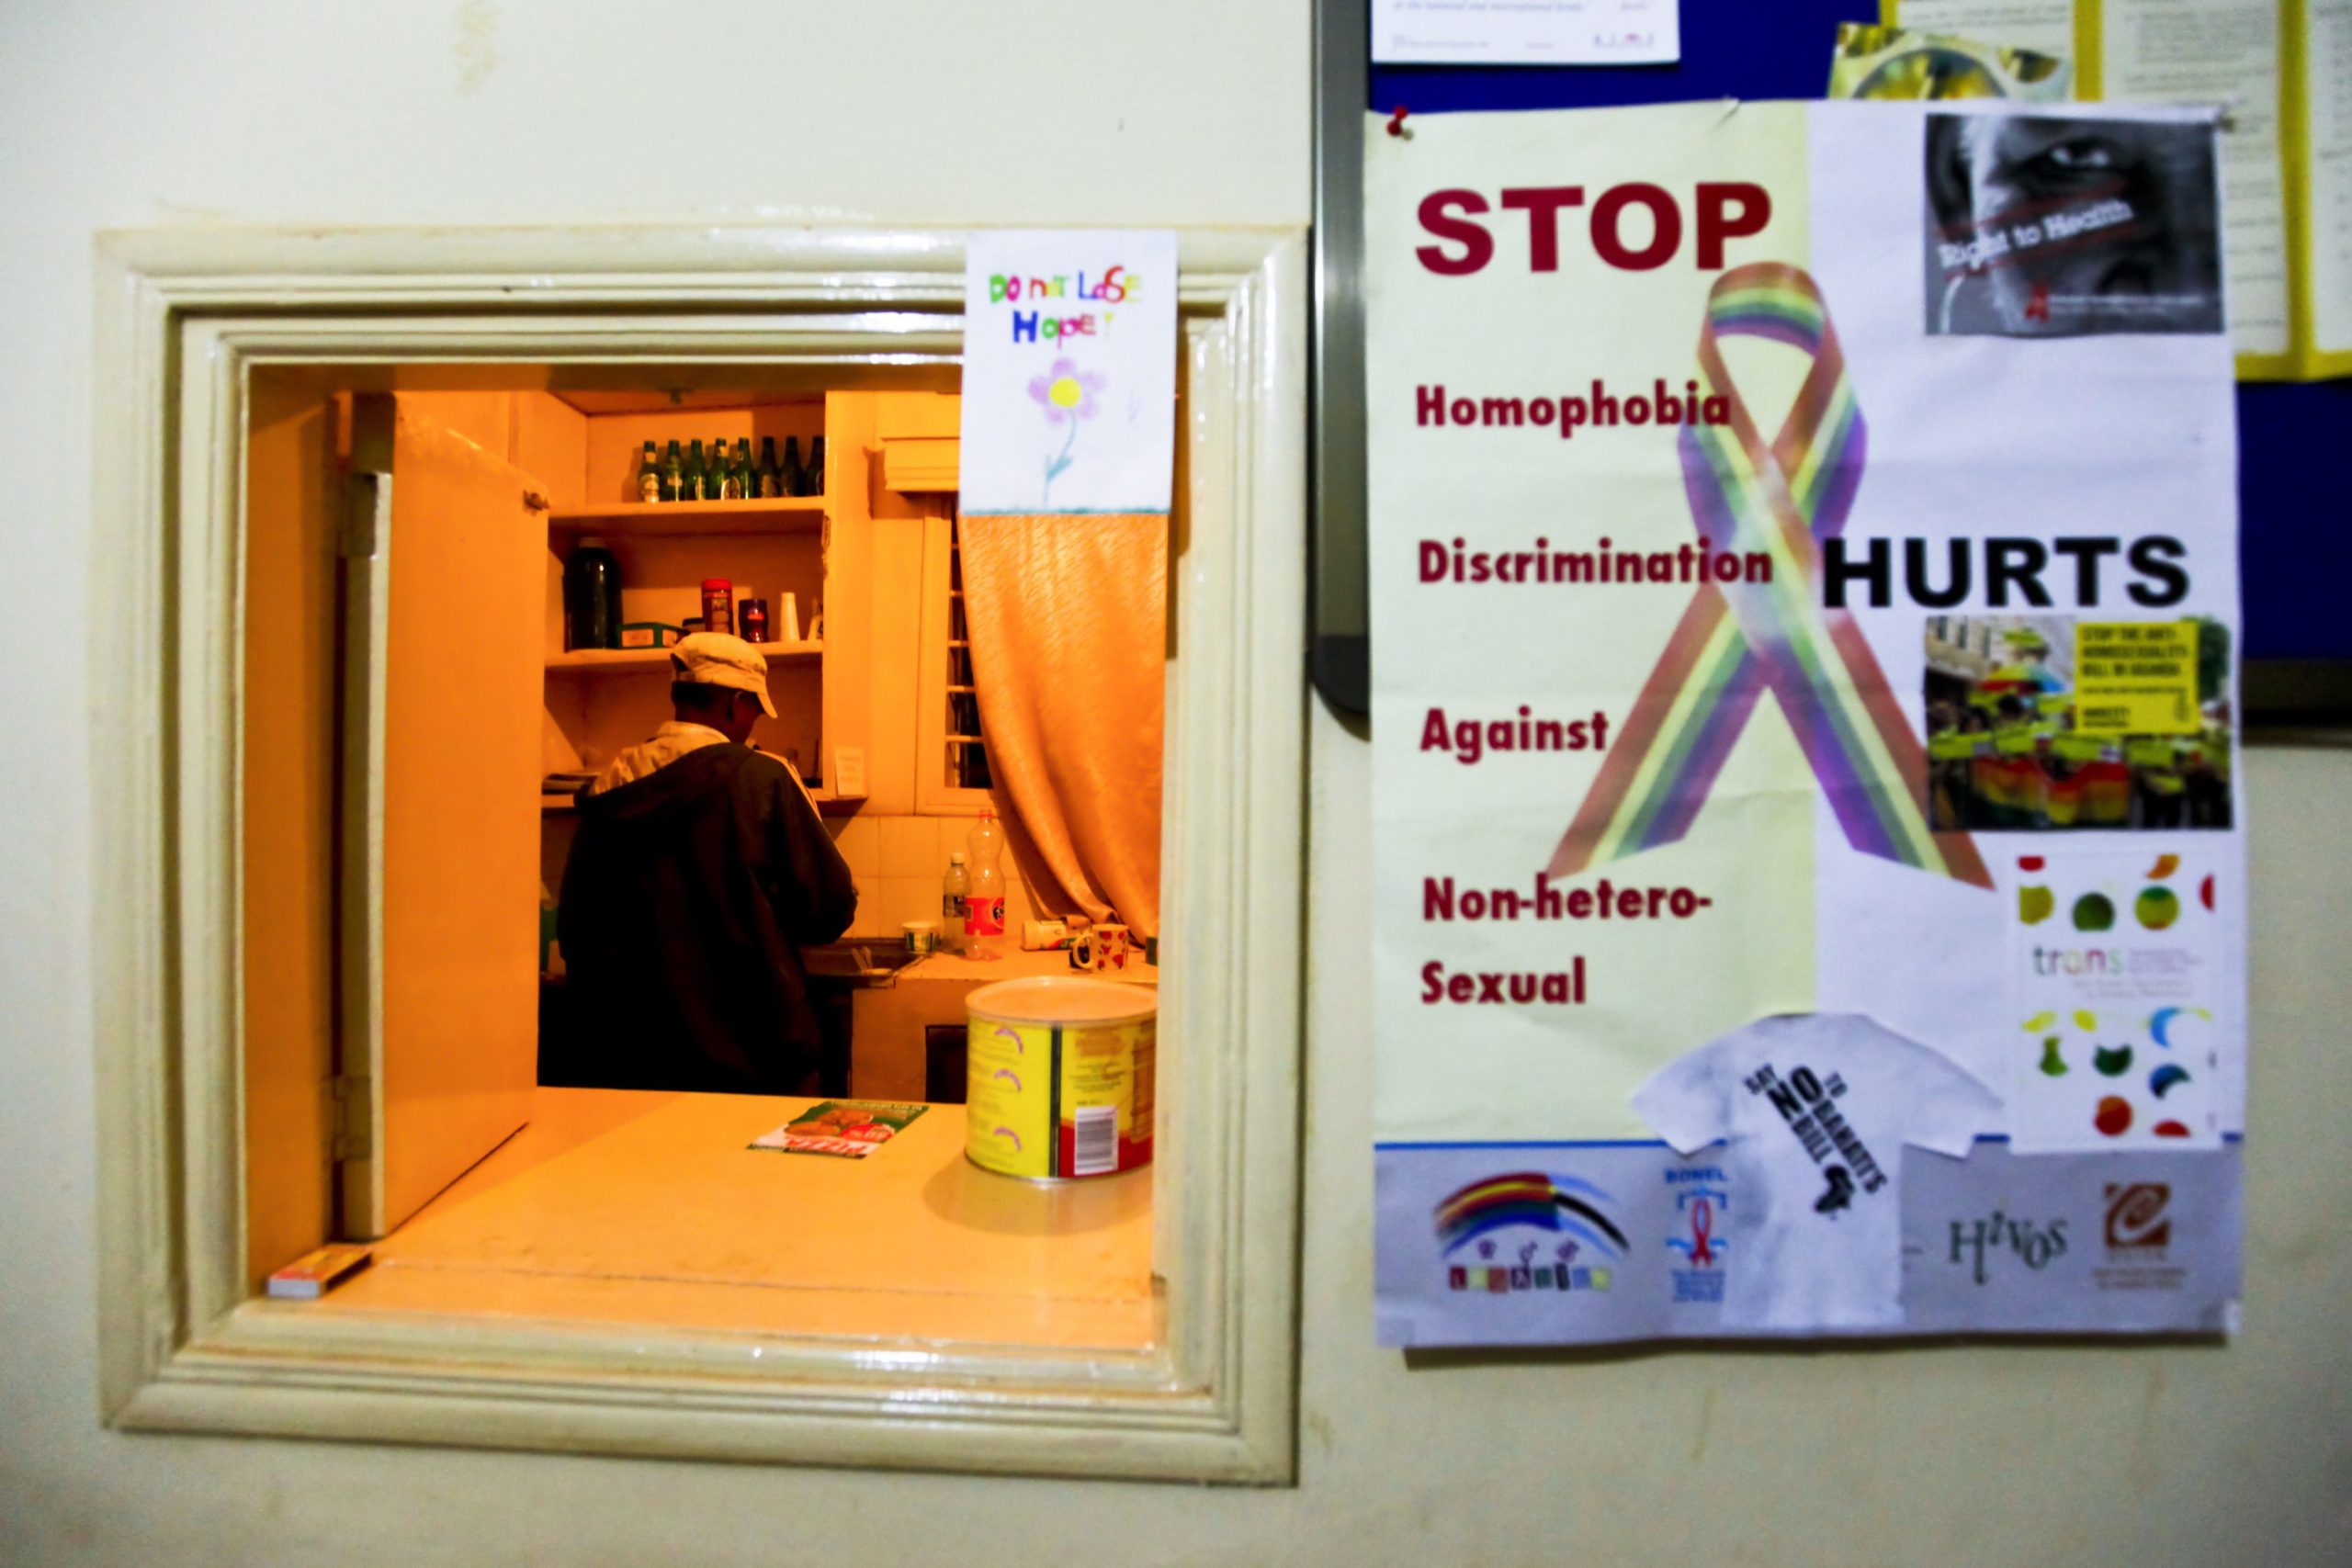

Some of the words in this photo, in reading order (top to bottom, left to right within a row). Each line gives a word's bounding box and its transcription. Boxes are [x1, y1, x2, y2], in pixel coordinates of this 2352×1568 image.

[1416, 182, 1772, 276] STOP
[1937, 225, 2010, 270] Right
[2012, 225, 2042, 248] to
[2042, 197, 2134, 241] Health
[1416, 378, 1732, 439] Homophobia
[1419, 536, 1774, 584] Discrimination
[1822, 535, 2191, 609] HURTS
[1419, 705, 1609, 763] Against
[1423, 872, 1713, 921] Non-hetero-
[1420, 955, 1587, 1005] Sexual
[2034, 945, 2124, 976] trans
[1767, 1064, 1824, 1122] NO
